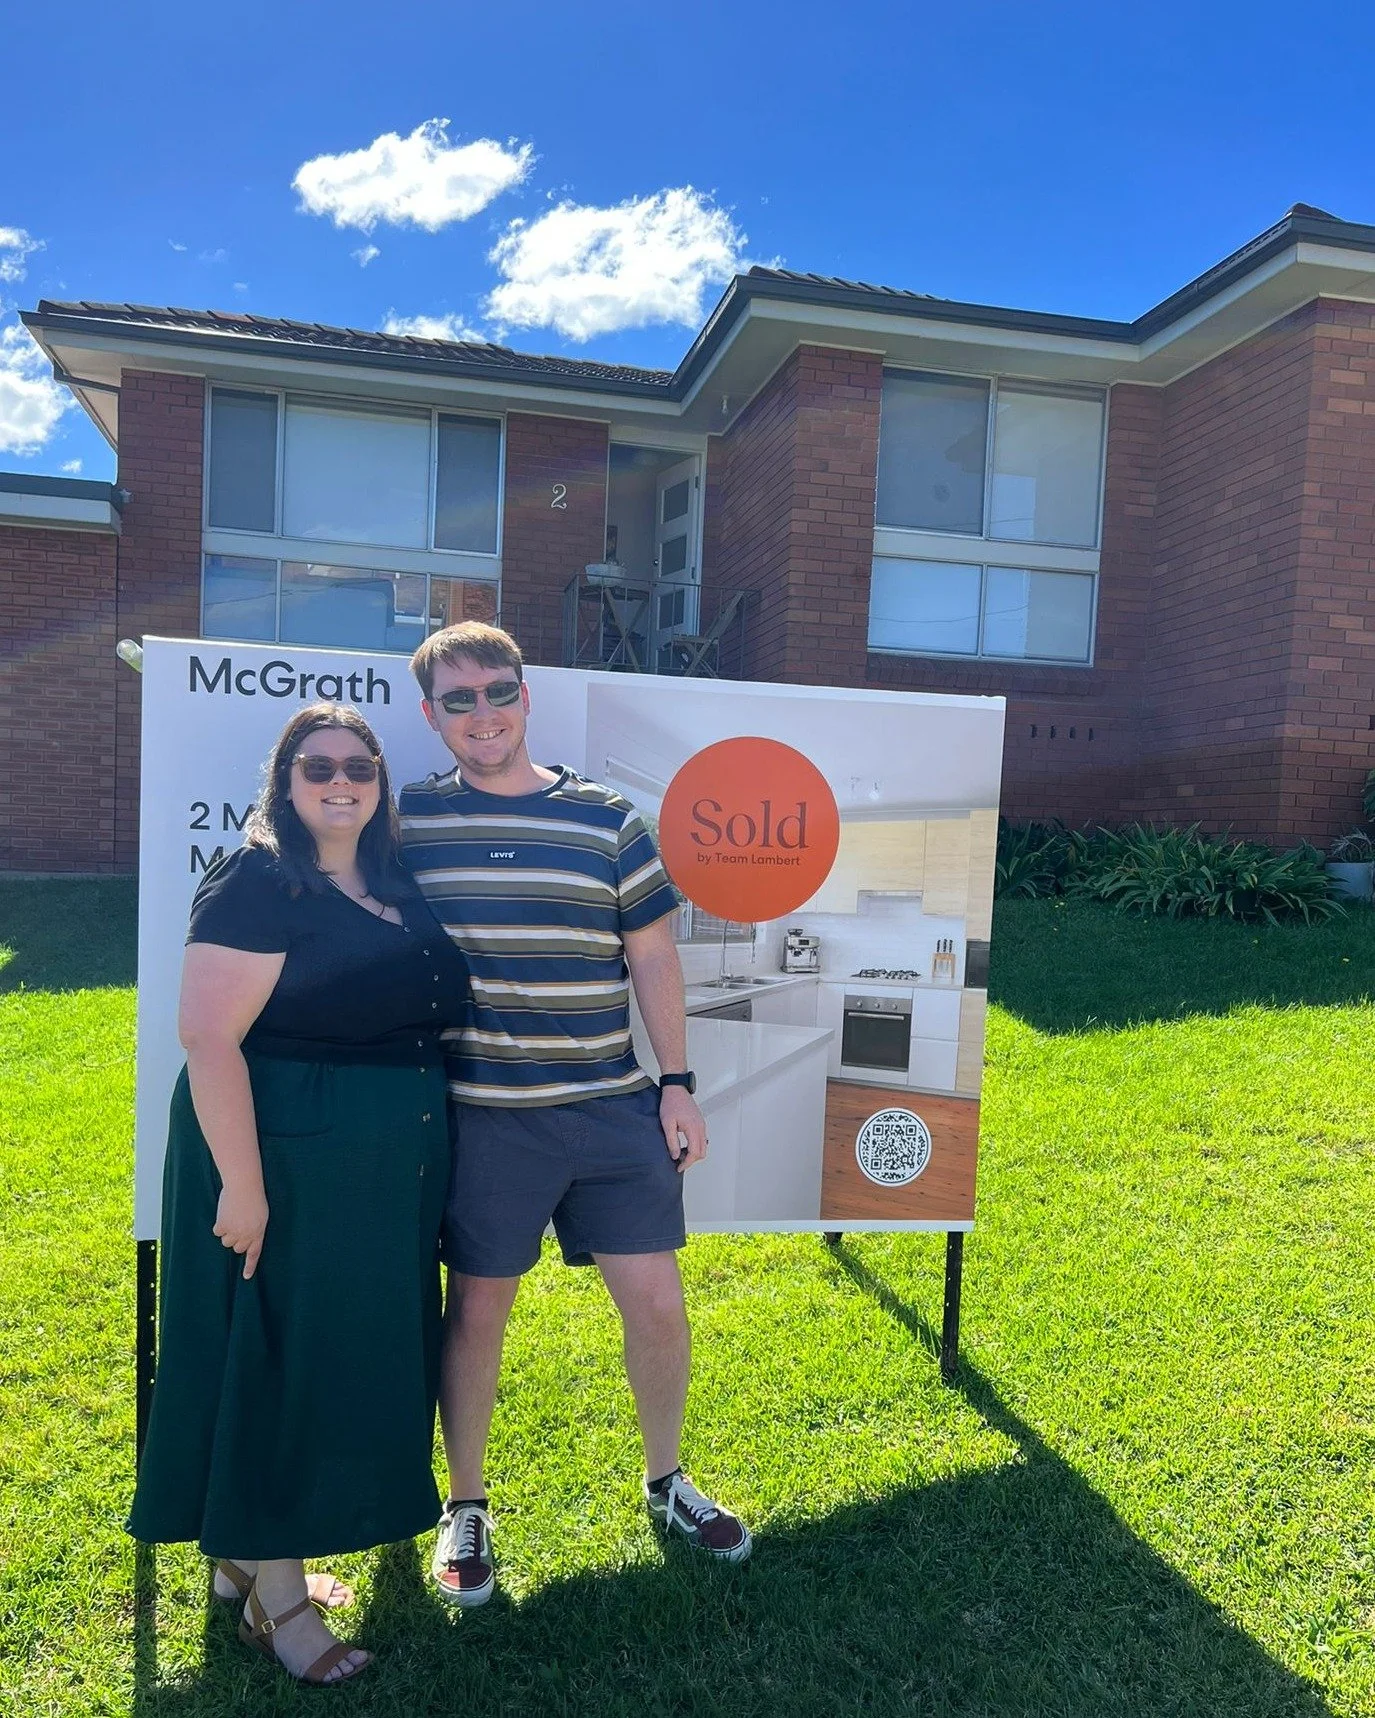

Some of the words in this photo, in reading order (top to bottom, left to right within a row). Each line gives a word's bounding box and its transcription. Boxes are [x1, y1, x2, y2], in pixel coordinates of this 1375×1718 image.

[551, 484, 567, 509] 2
[189, 655, 391, 705] McGrath
[190, 802, 210, 830] 2
[690, 799, 809, 849] Sold
[697, 852, 711, 865] by
[716, 853, 748, 864] Team
[752, 854, 800, 866] Lambert
